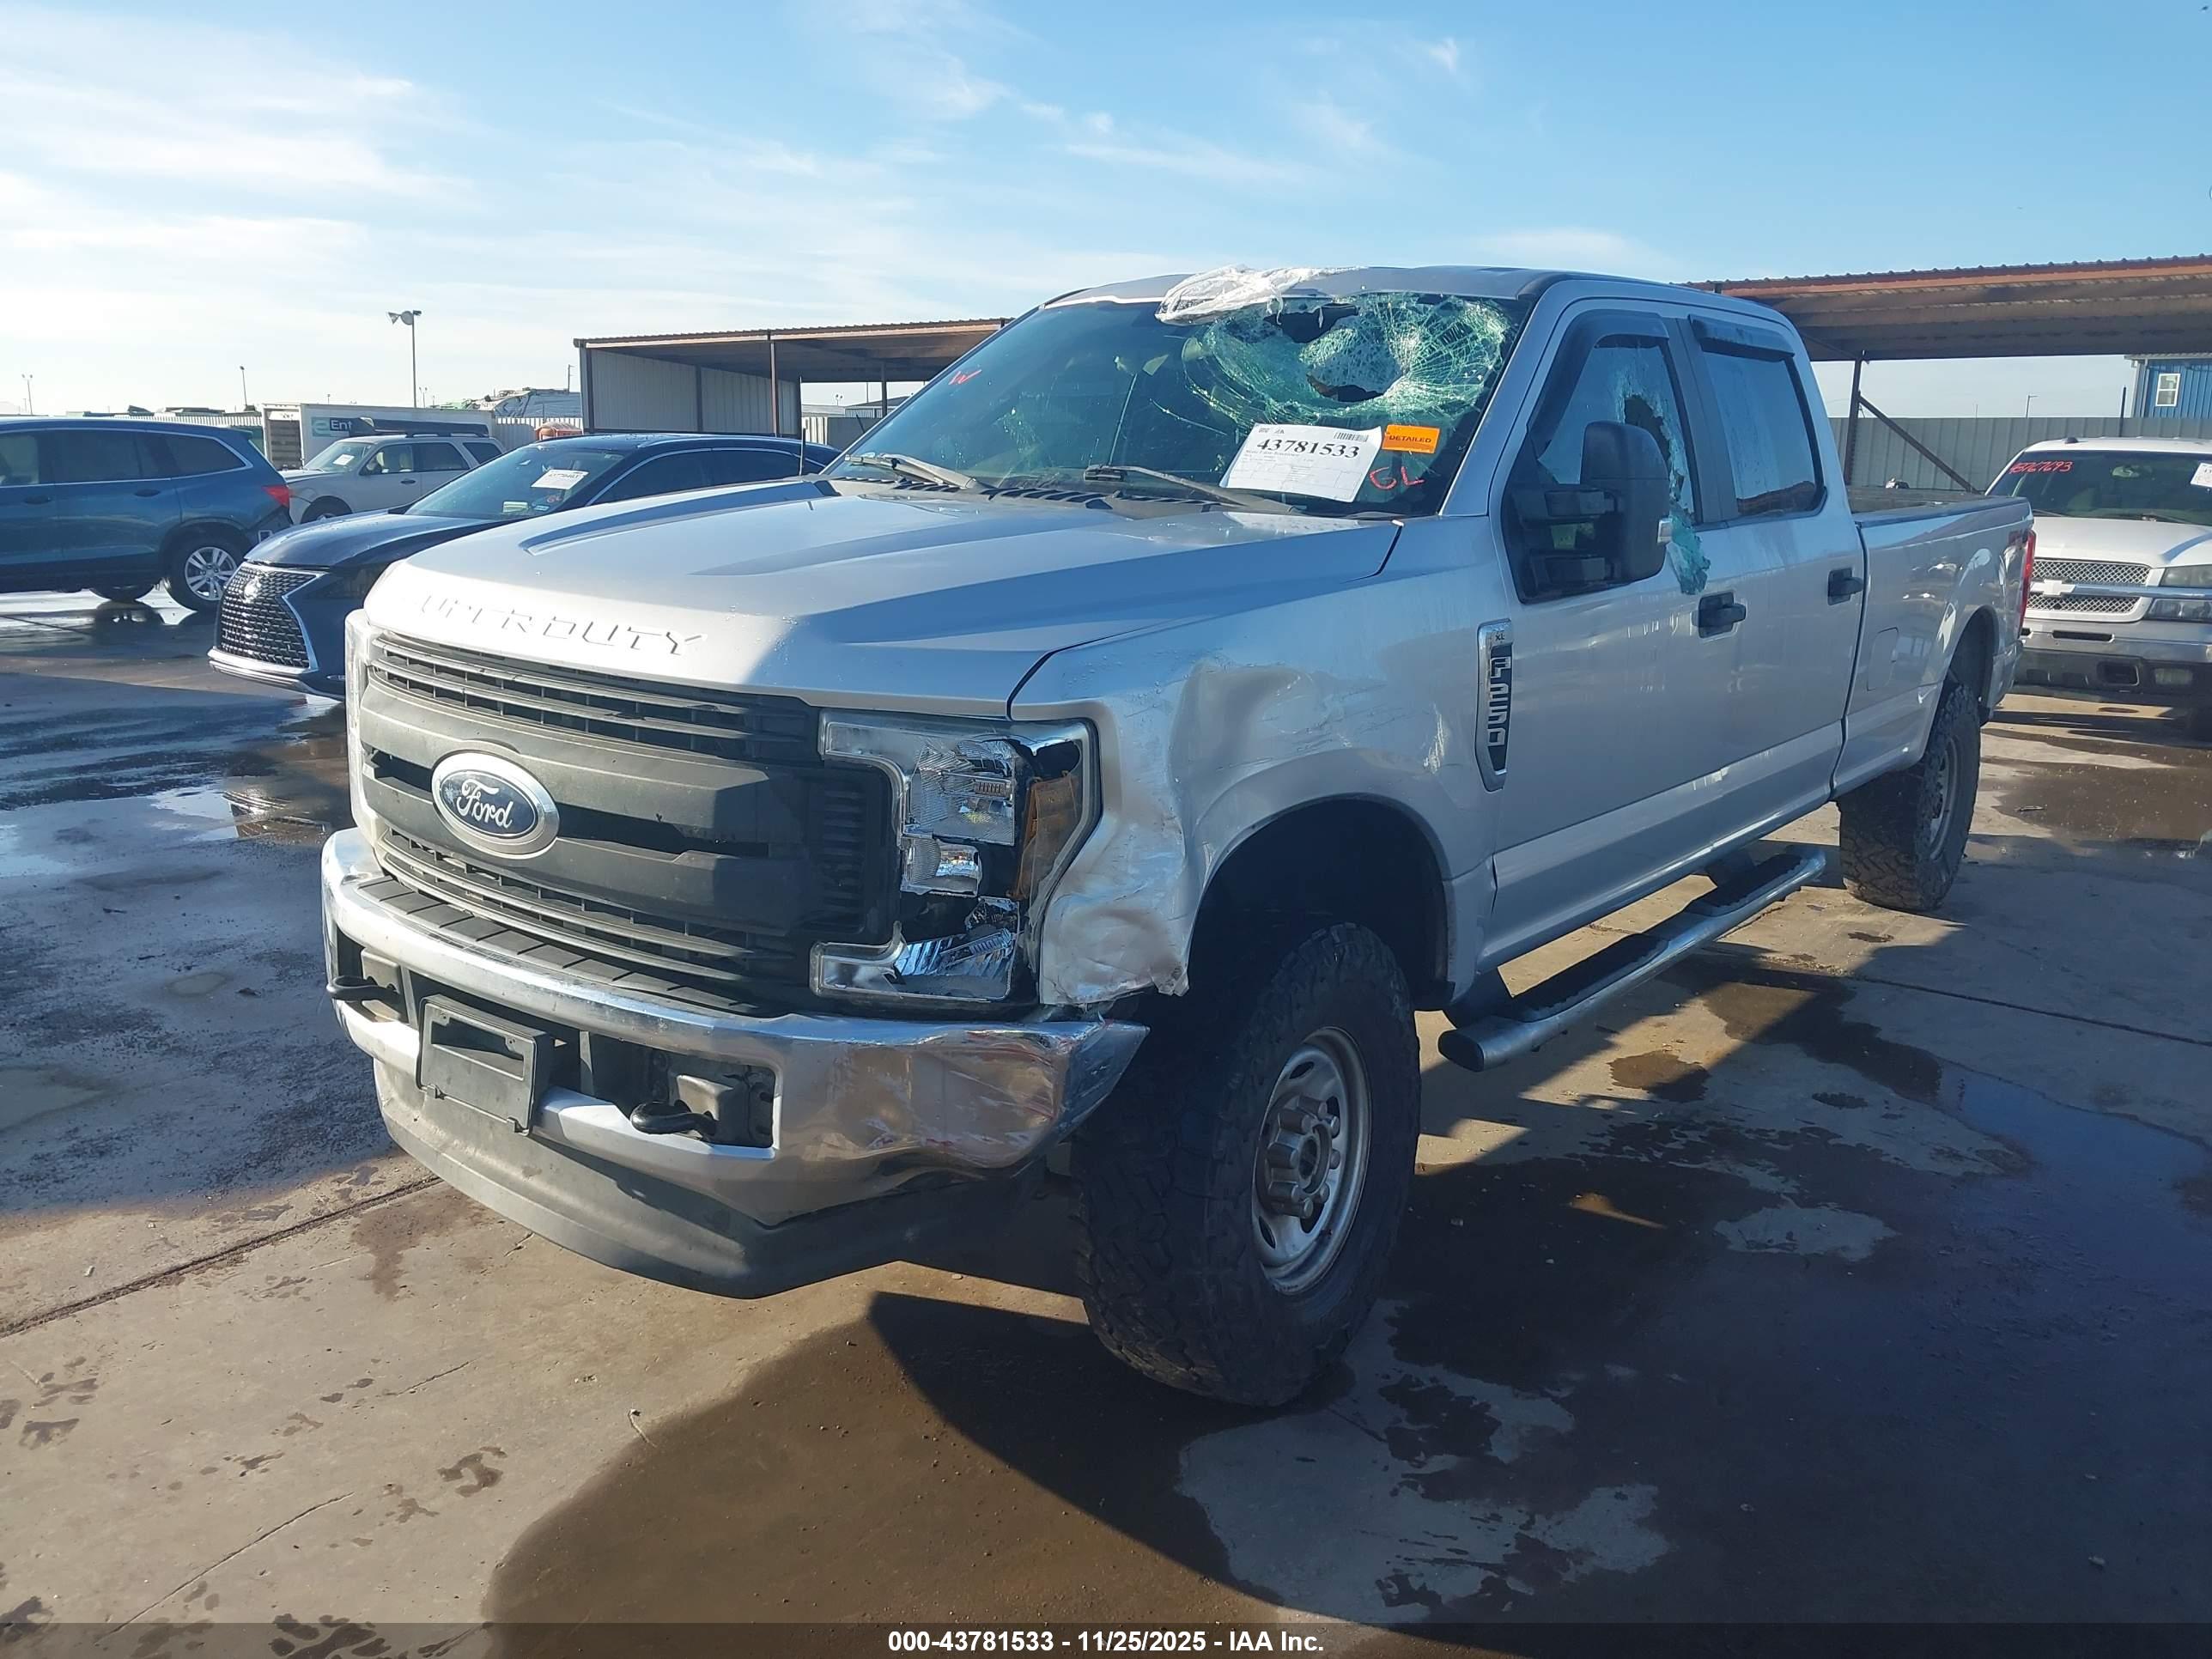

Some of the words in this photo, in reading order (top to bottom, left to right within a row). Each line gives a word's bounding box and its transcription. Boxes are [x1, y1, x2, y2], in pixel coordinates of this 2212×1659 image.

[1256, 438, 1360, 459] 43781533
[1389, 434, 1432, 443] DETAILED
[543, 615, 708, 655] DUTY
[456, 778, 514, 829] Ford
